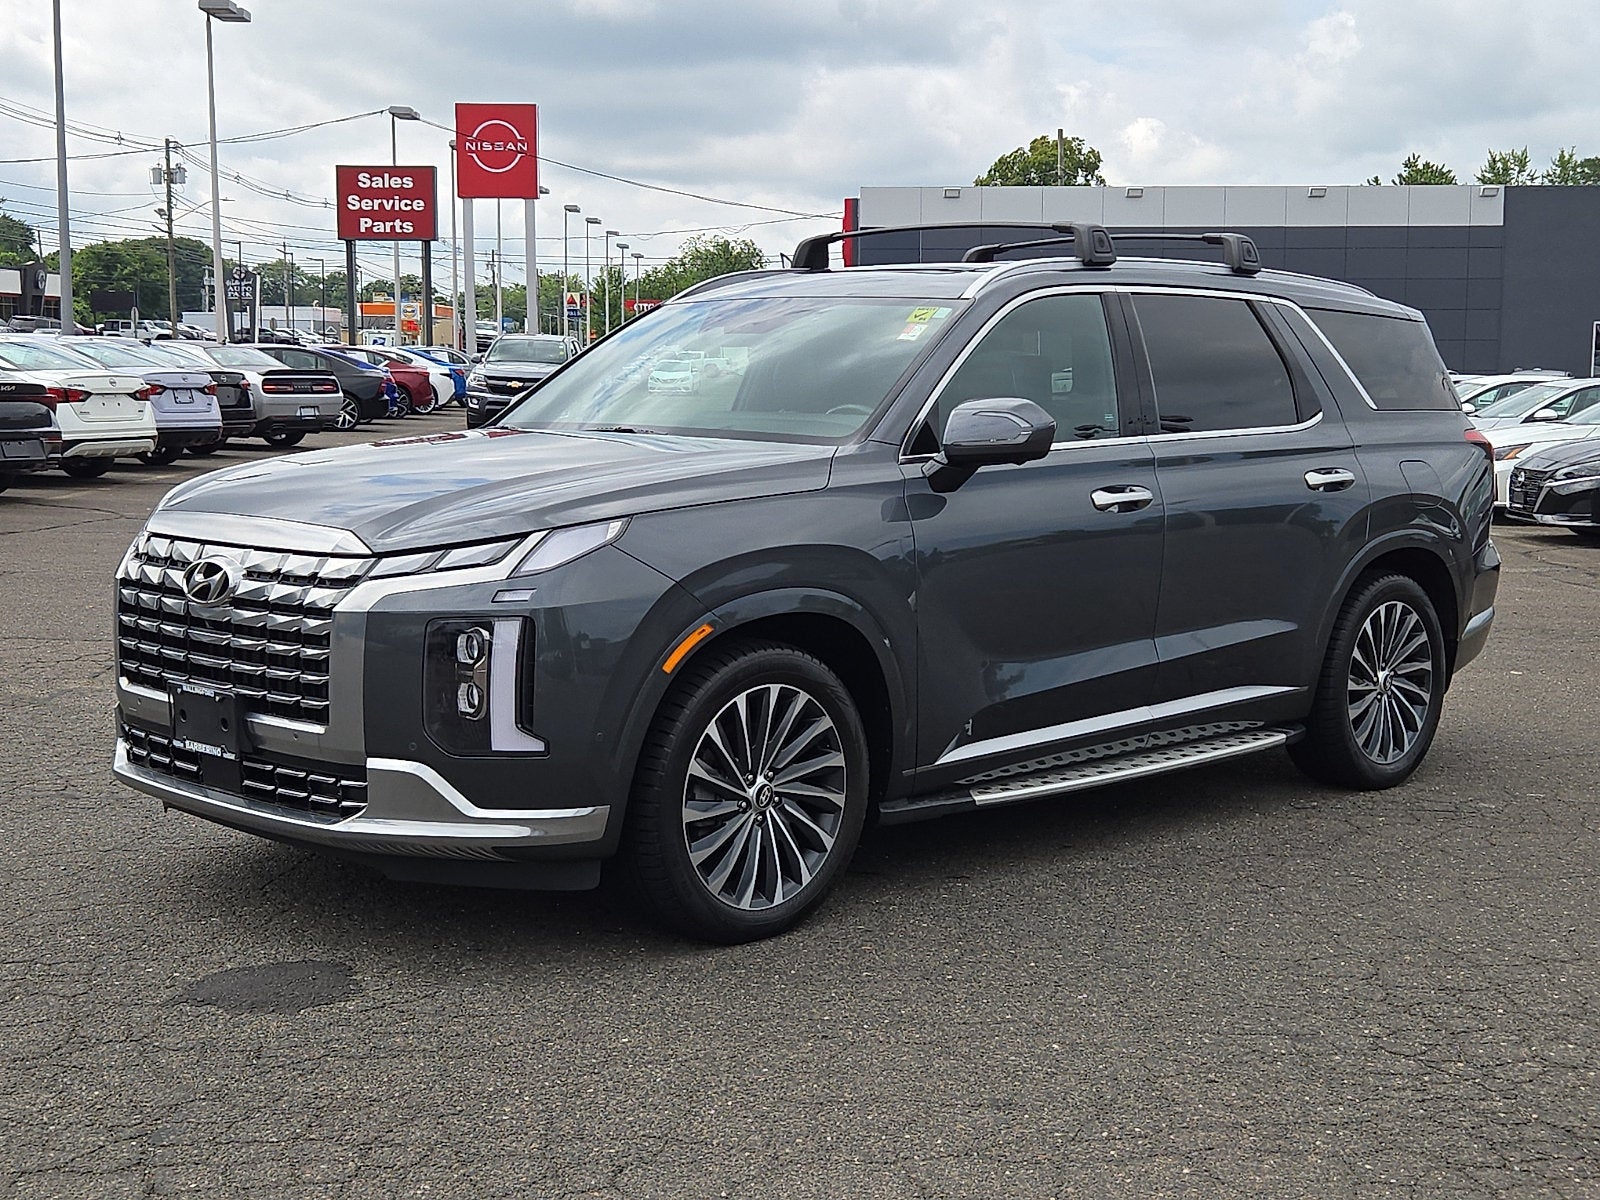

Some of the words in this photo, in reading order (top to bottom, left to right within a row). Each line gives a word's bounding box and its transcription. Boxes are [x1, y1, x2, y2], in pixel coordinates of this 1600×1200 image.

[465, 141, 528, 151] NISSAN
[357, 173, 414, 188] Sales
[347, 195, 425, 211] Service
[359, 218, 414, 233] Parts
[633, 303, 656, 312] CITG
